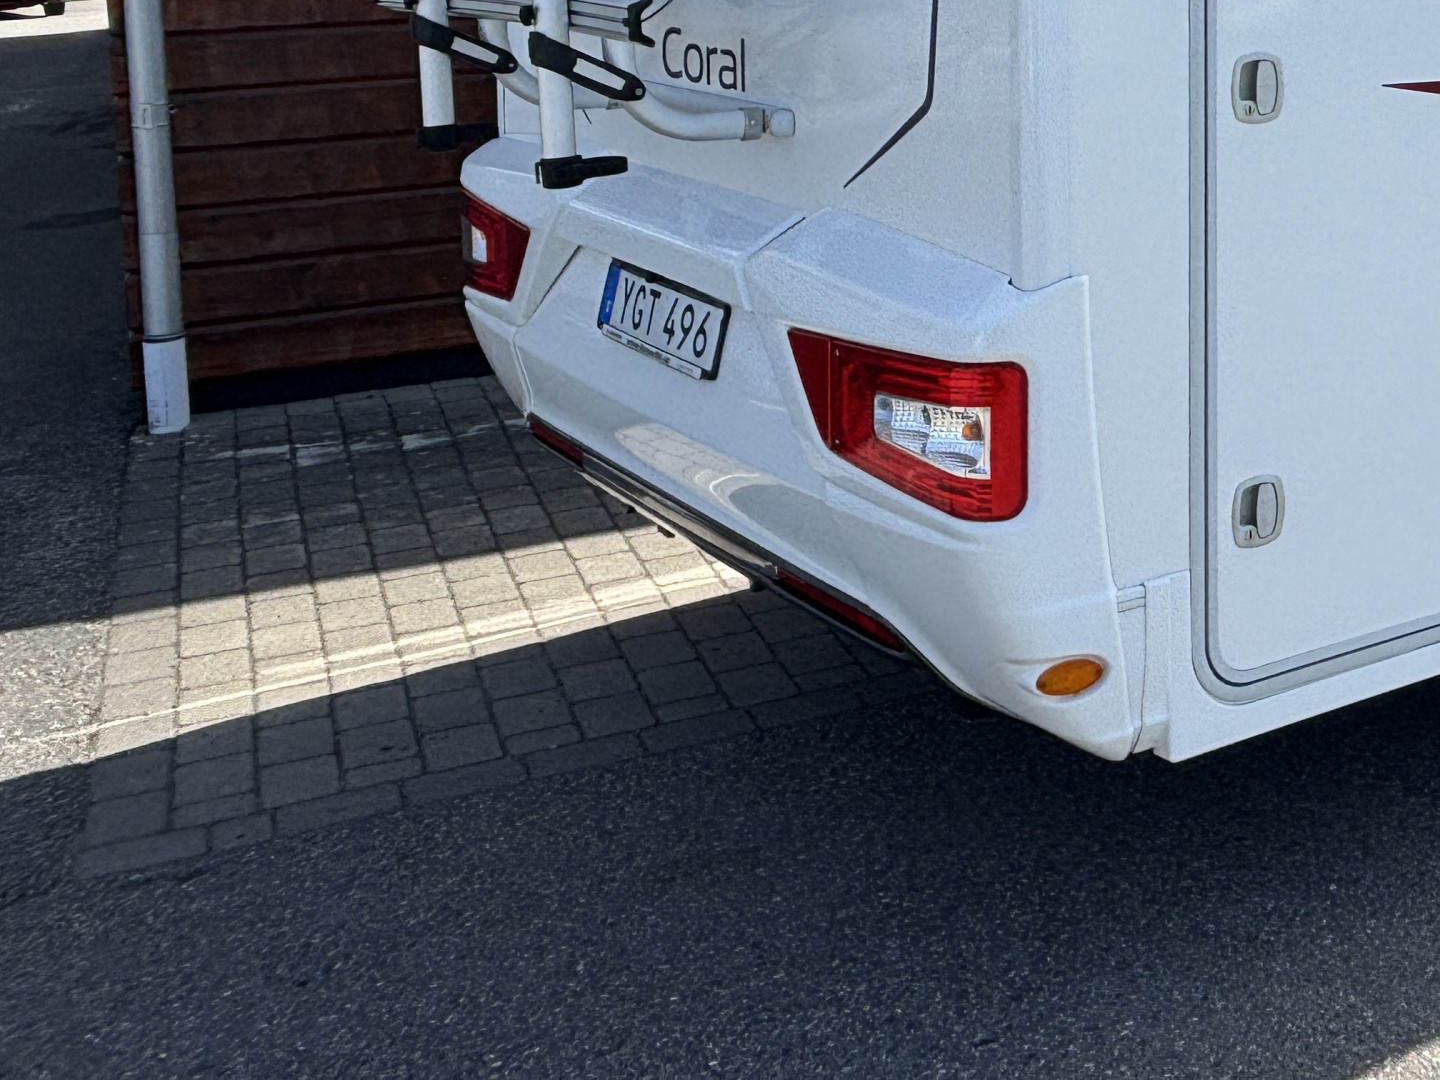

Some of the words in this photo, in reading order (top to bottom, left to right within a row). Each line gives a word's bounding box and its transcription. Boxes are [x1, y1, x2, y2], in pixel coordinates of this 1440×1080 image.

[662, 26, 745, 93] Coral
[620, 277, 662, 336] YGT
[662, 297, 711, 358] 496
